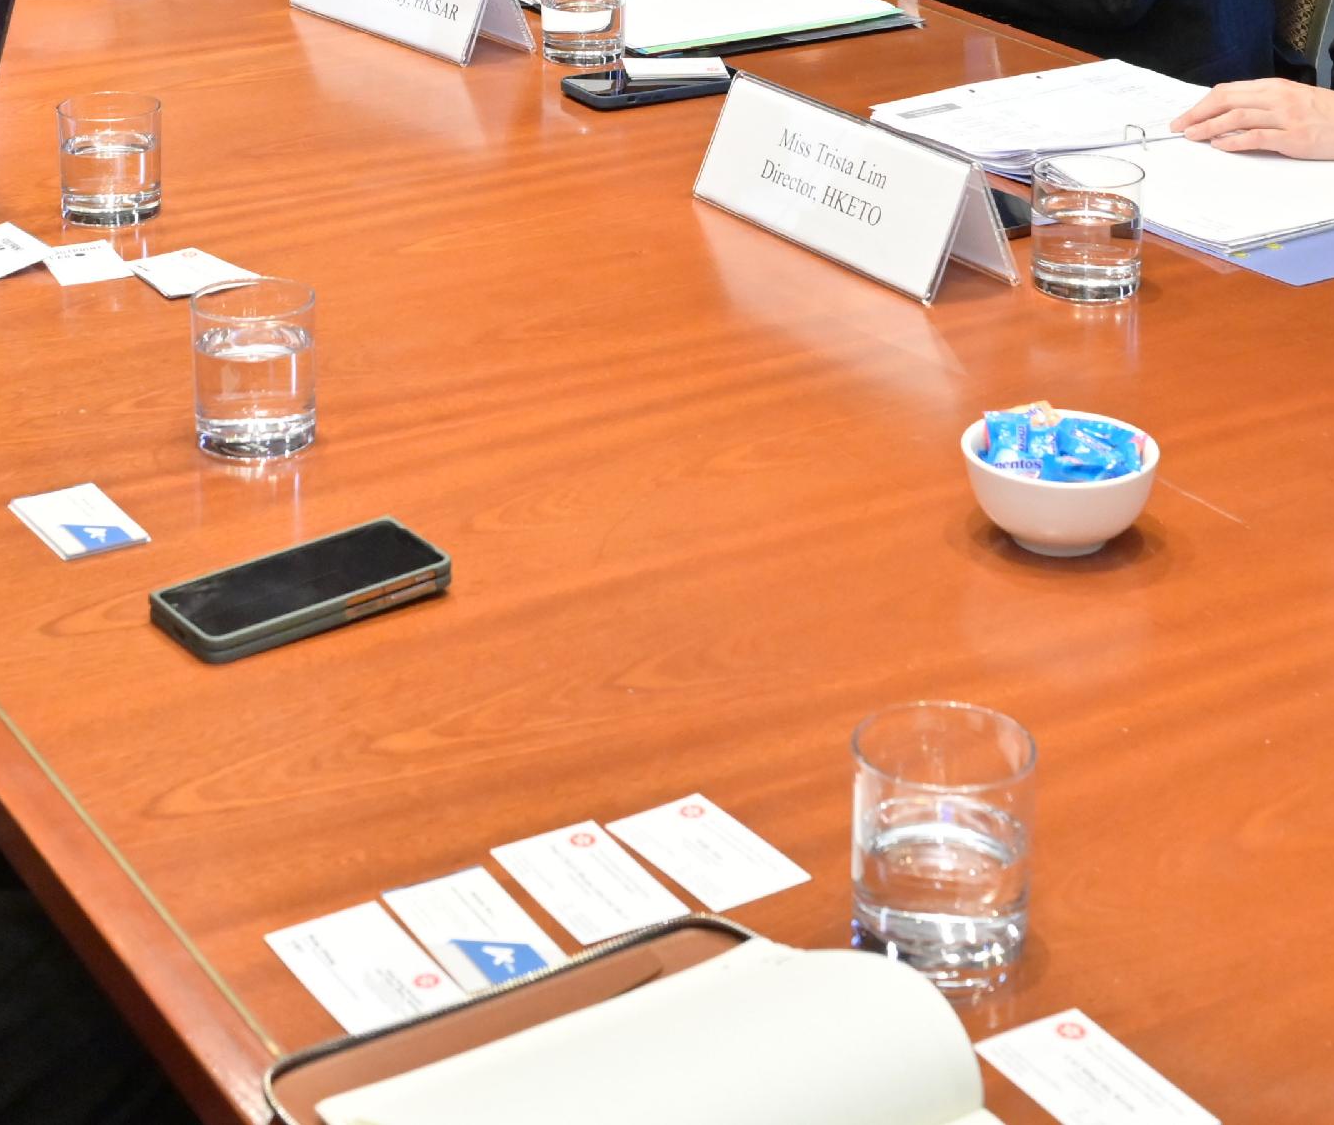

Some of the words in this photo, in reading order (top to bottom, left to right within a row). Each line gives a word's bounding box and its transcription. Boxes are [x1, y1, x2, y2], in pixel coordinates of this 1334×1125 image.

[778, 127, 811, 159] Miss
[814, 143, 855, 177] Trista
[856, 159, 889, 190] Lim
[820, 185, 883, 227] HKETO
